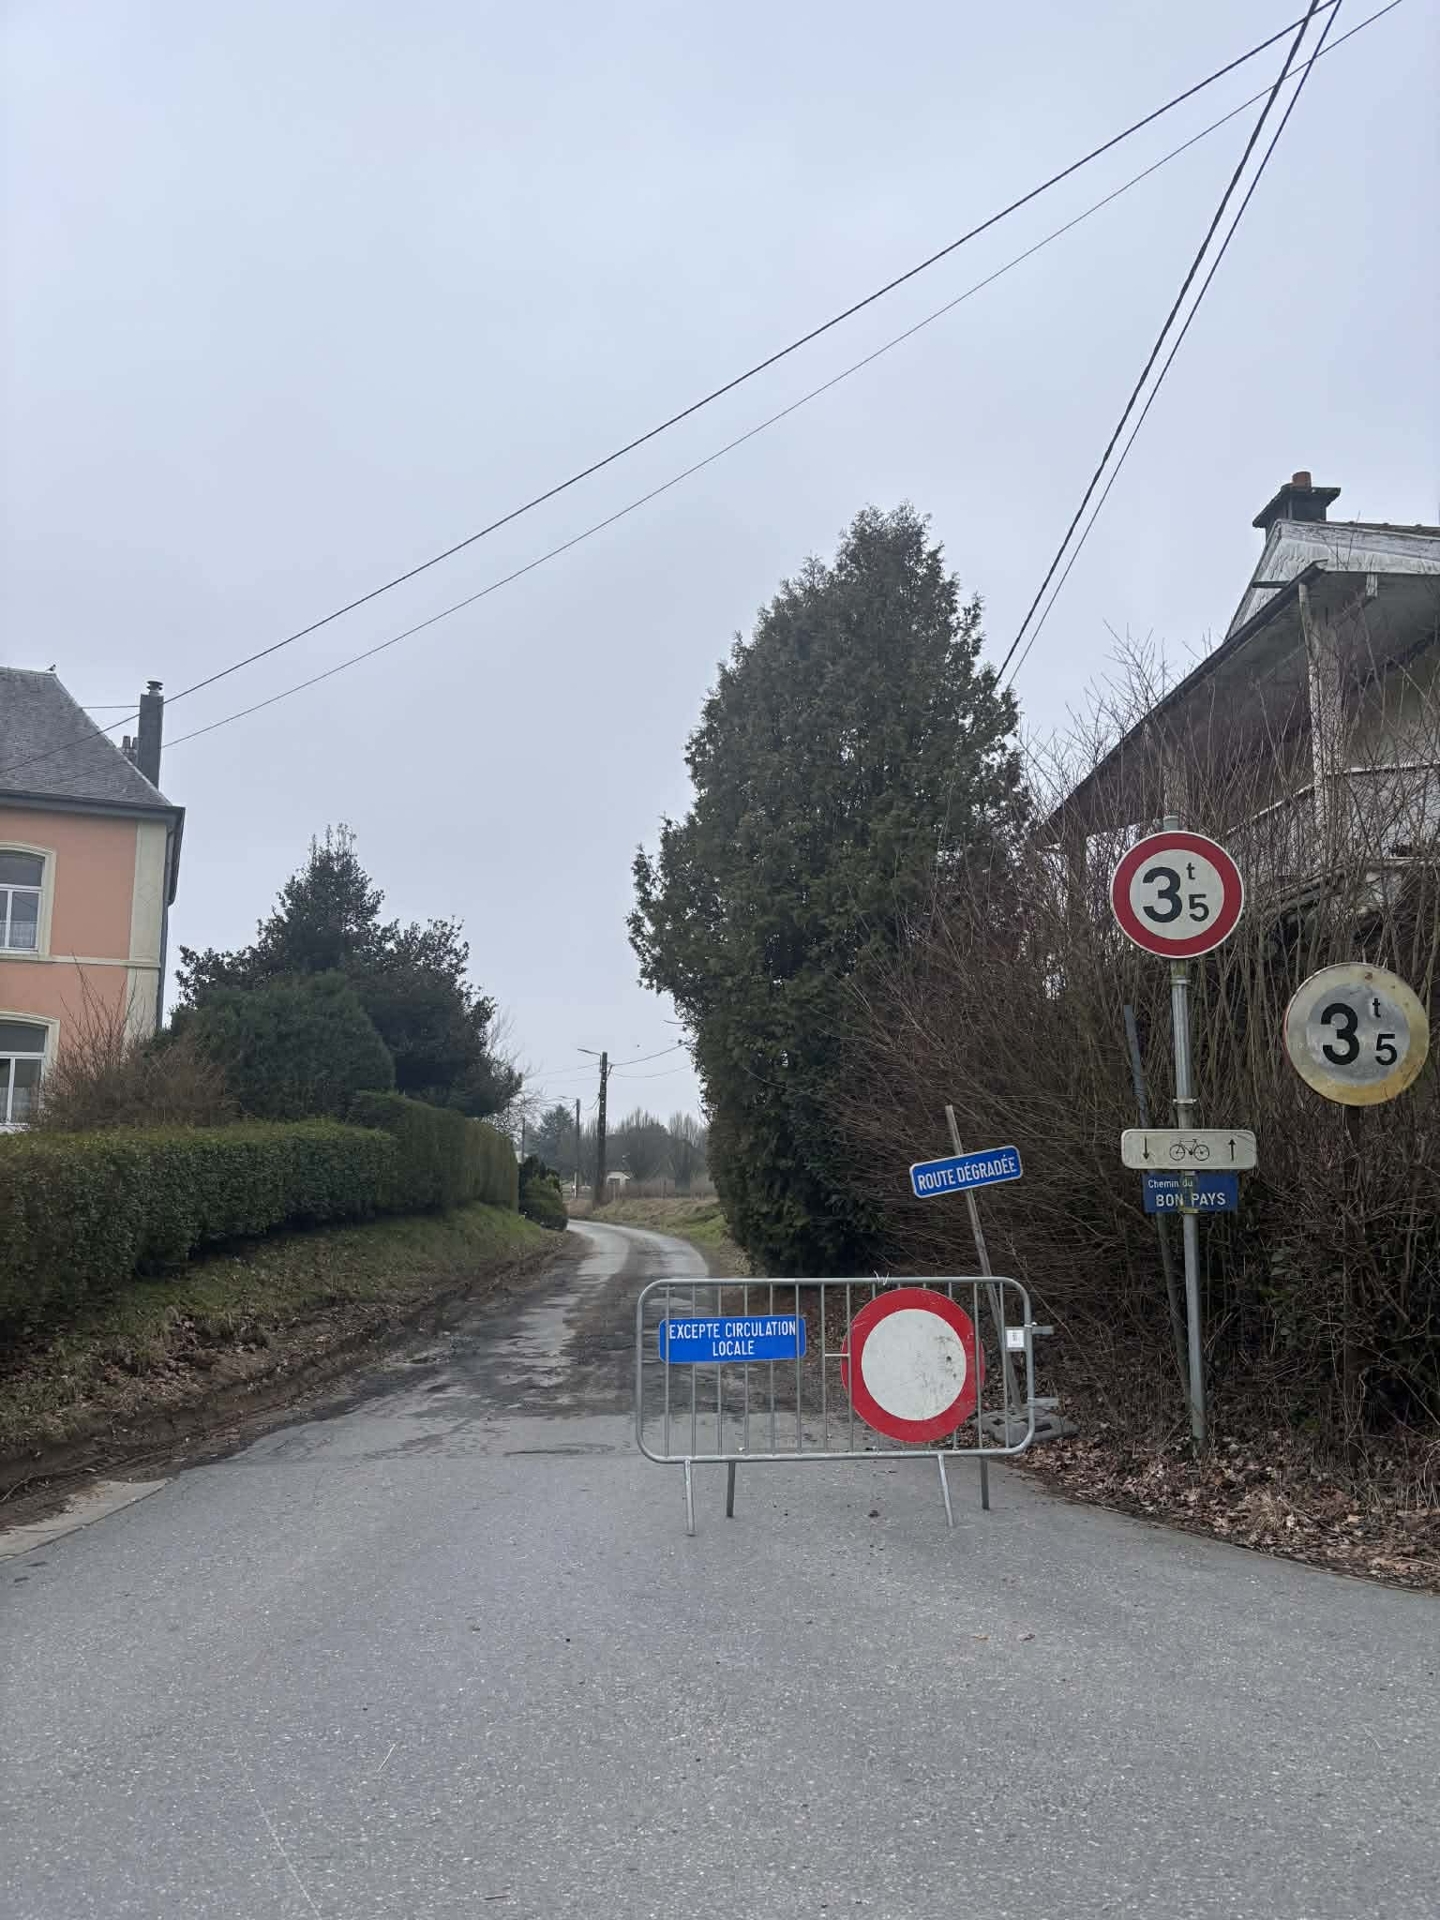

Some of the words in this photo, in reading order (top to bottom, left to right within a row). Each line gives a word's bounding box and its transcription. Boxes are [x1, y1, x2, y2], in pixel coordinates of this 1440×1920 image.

[917, 1168, 956, 1191] ROUTE
[956, 1154, 1017, 1183] DÉGRADÉE
[1147, 1178, 1179, 1189] Chemin
[1182, 1177, 1193, 1187] du
[1155, 1193, 1184, 1207] BON
[1191, 1192, 1227, 1207] PAYS
[669, 1322, 721, 1340] EXCEPTE
[725, 1320, 796, 1338] CIRCULATION
[711, 1340, 756, 1357] LOCALE
